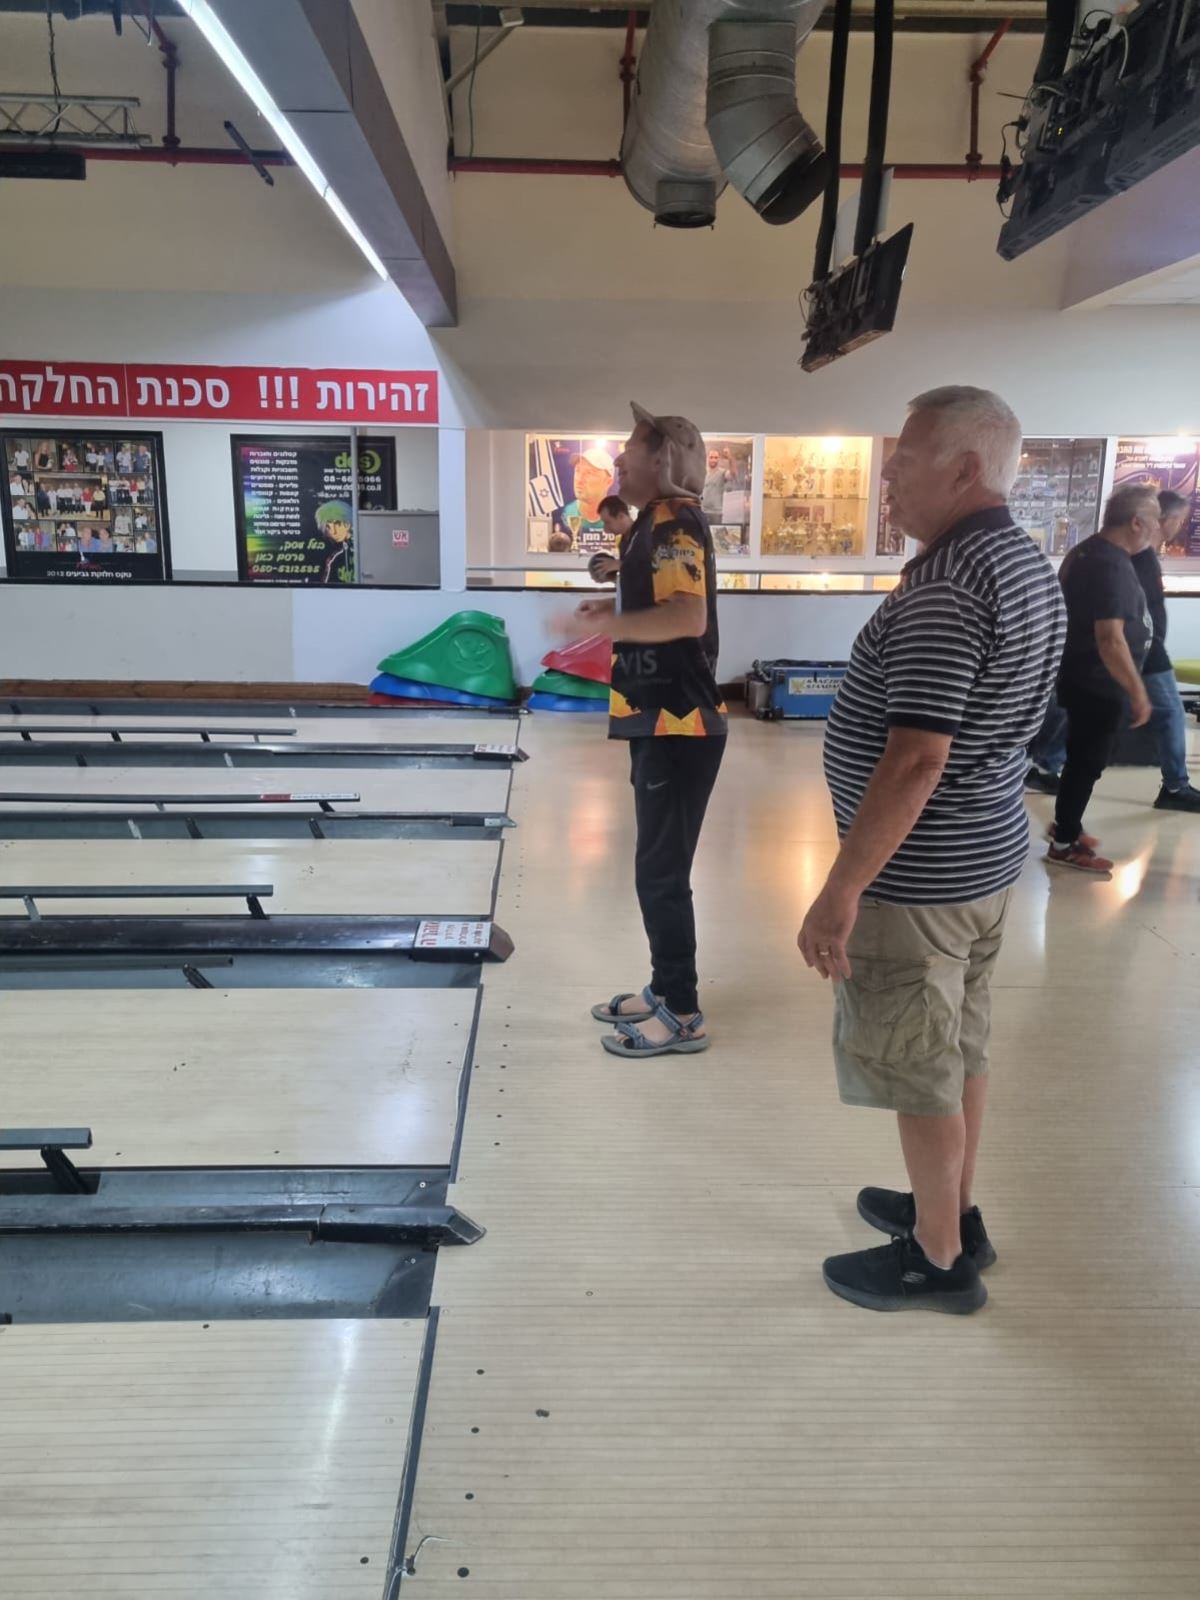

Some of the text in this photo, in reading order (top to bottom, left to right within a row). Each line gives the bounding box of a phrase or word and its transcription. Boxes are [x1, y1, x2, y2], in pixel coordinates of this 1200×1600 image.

[0, 366, 429, 412] זהירות !!! סכנת החלקה
